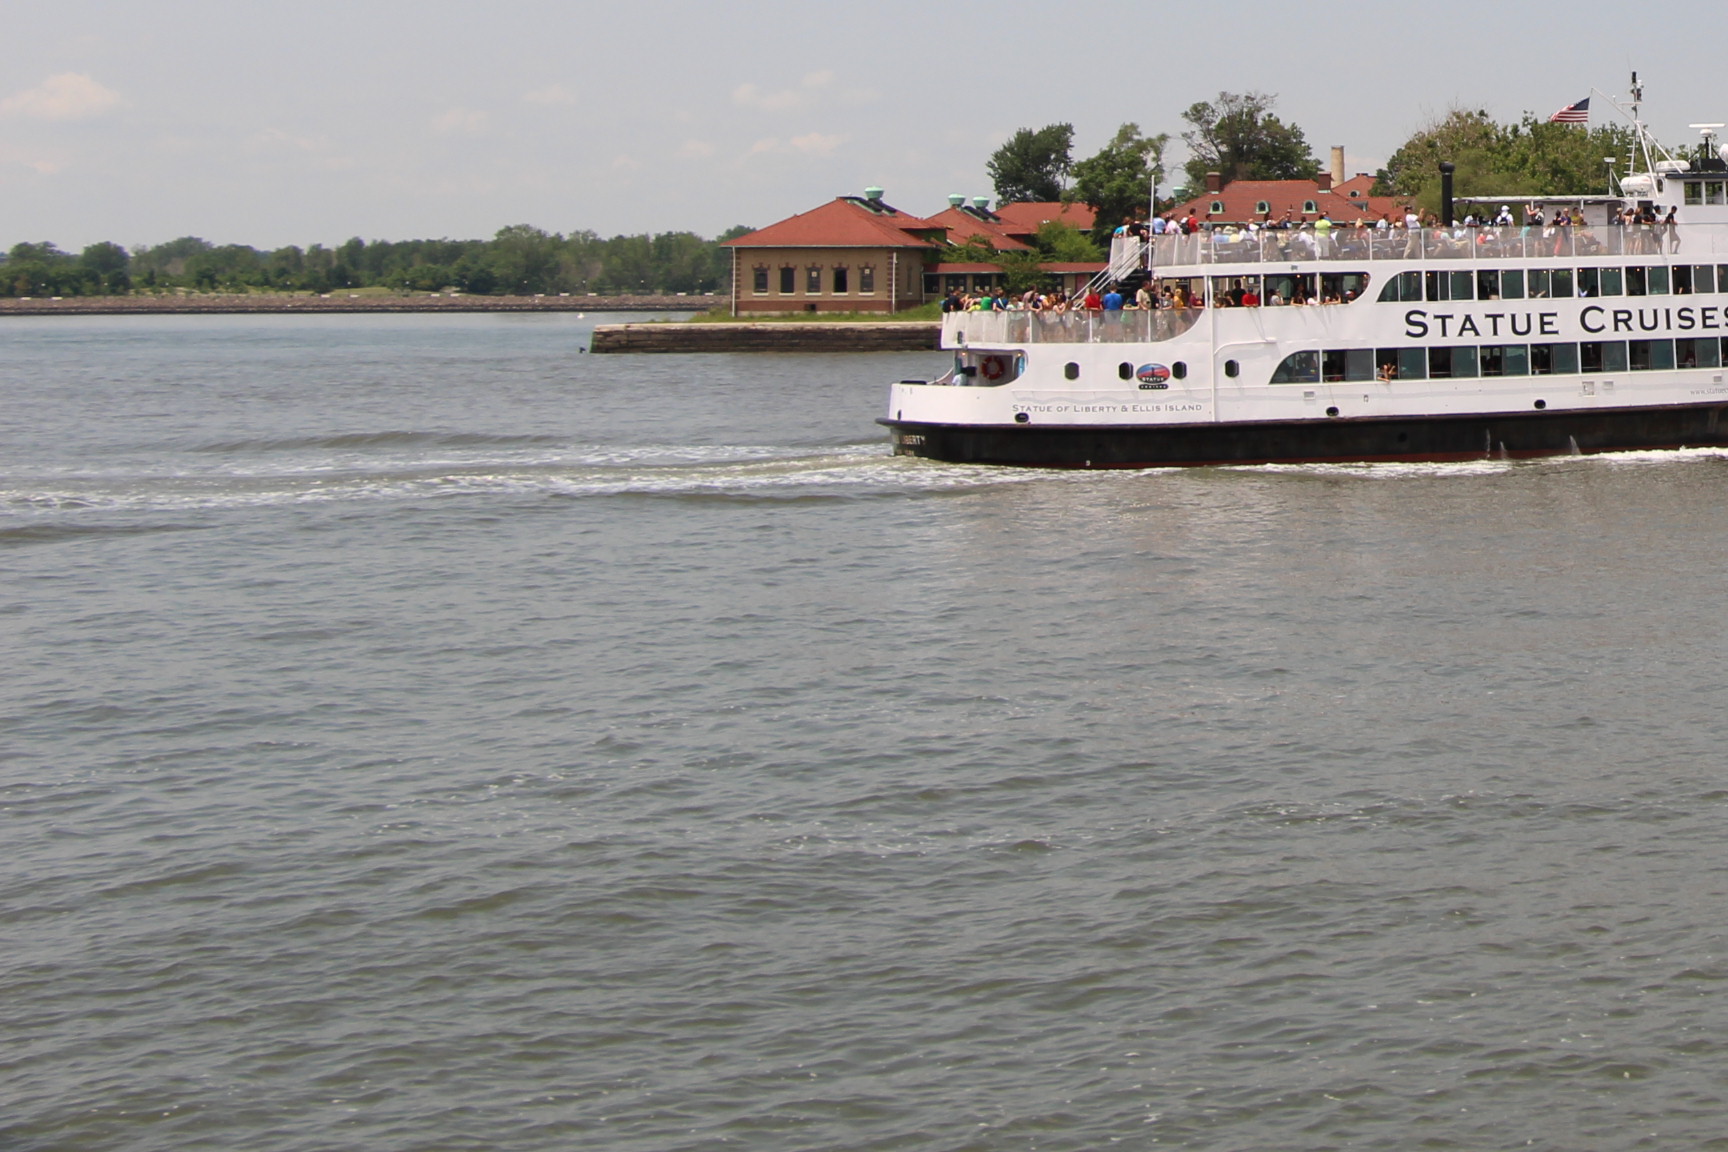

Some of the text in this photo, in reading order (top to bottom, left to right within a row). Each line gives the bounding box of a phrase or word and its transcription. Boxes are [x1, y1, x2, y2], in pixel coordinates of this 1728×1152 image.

[1404, 309, 1560, 338] STATUE
[1012, 404, 1203, 413] STATUE OF LIBERTY & ELLIS ISLAND
